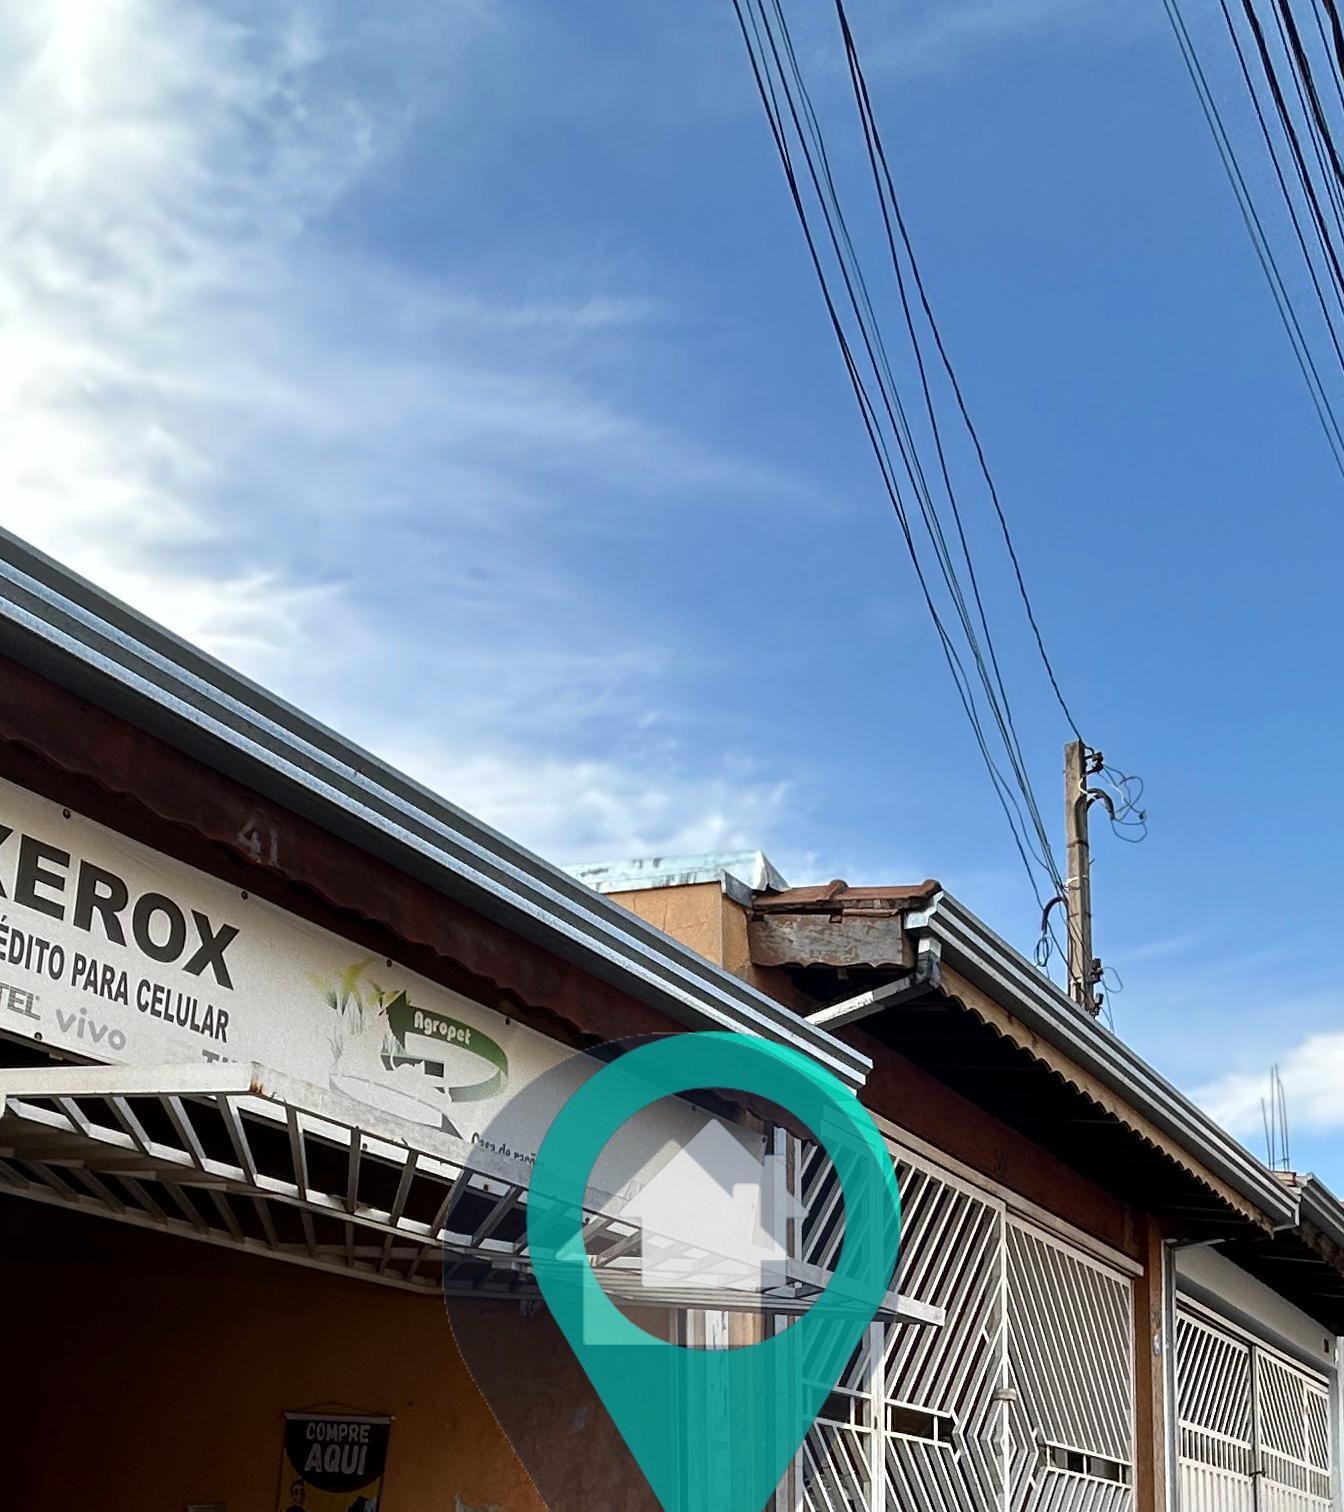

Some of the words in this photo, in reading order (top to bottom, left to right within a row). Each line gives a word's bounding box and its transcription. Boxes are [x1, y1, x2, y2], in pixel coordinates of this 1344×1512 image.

[71, 952, 130, 1006] PARA
[136, 979, 229, 1043] CELULAR
[56, 1007, 126, 1051] vivo
[413, 1011, 472, 1046] Agropet
[306, 1422, 371, 1443] COMPRE
[304, 1443, 368, 1476] AQUI
